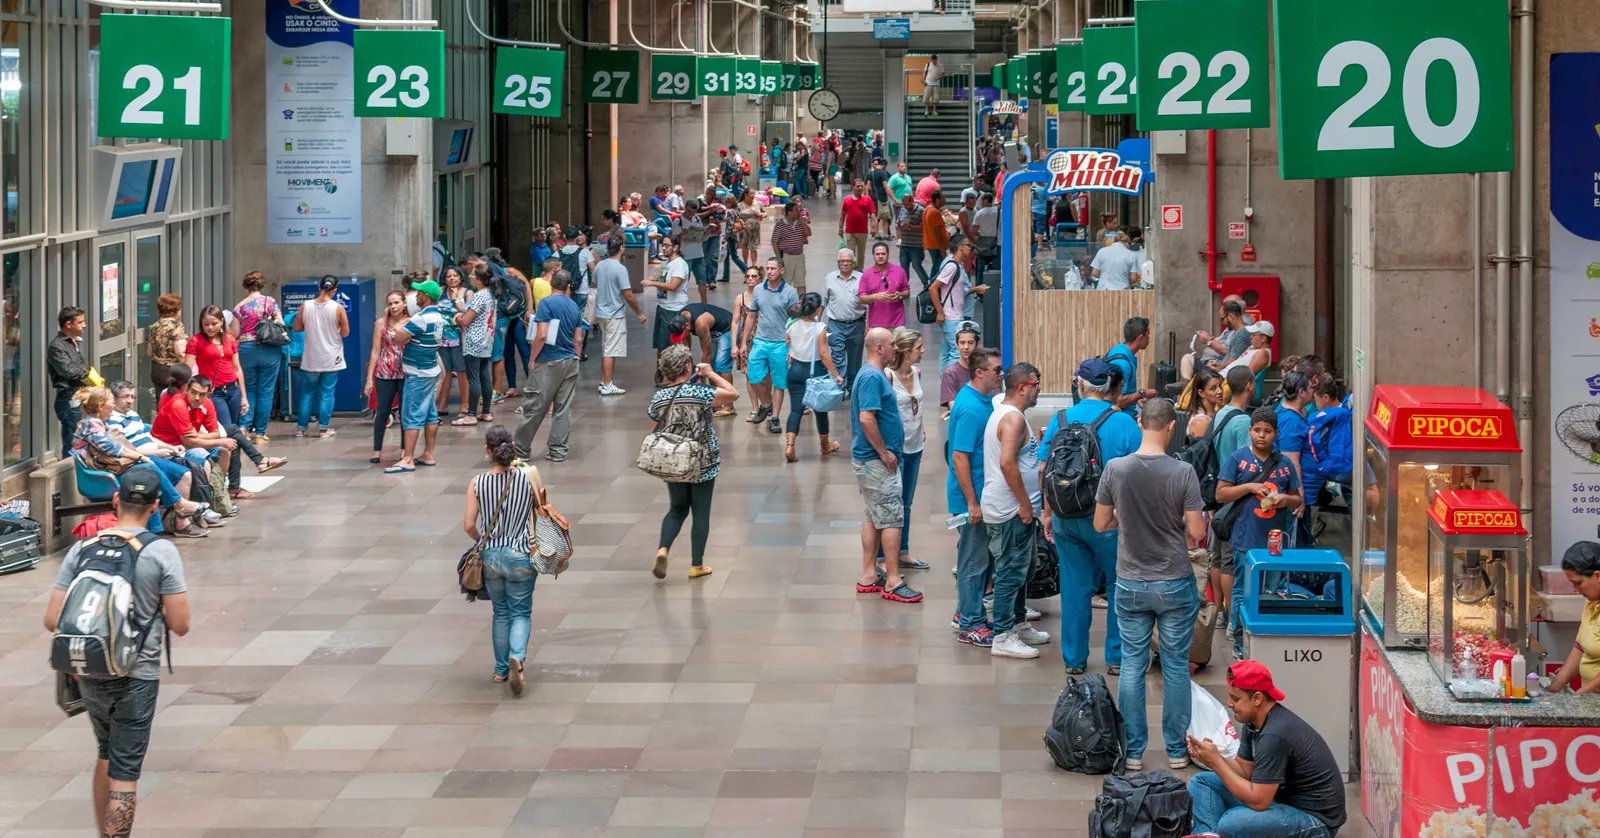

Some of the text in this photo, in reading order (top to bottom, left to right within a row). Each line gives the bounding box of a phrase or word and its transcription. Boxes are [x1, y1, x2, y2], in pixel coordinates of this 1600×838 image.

[366, 65, 430, 108] 23
[502, 74, 552, 109] 25
[592, 70, 631, 98] 27
[656, 71, 690, 95] 29
[704, 72, 730, 92] 31
[736, 72, 756, 90] 33
[1067, 71, 1087, 103] 2
[1157, 50, 1251, 115] 22
[121, 64, 201, 125] 21
[1316, 37, 1480, 151] 20
[1069, 153, 1119, 171] Via
[1412, 416, 1499, 437] PIPOCA
[1572, 482, 1585, 492] Só
[1572, 505, 1584, 514] de
[1588, 495, 1600, 503] do
[1456, 512, 1515, 526] PIPOCA
[1284, 649, 1323, 662] LIXO
[1445, 734, 1600, 804] PIPO
